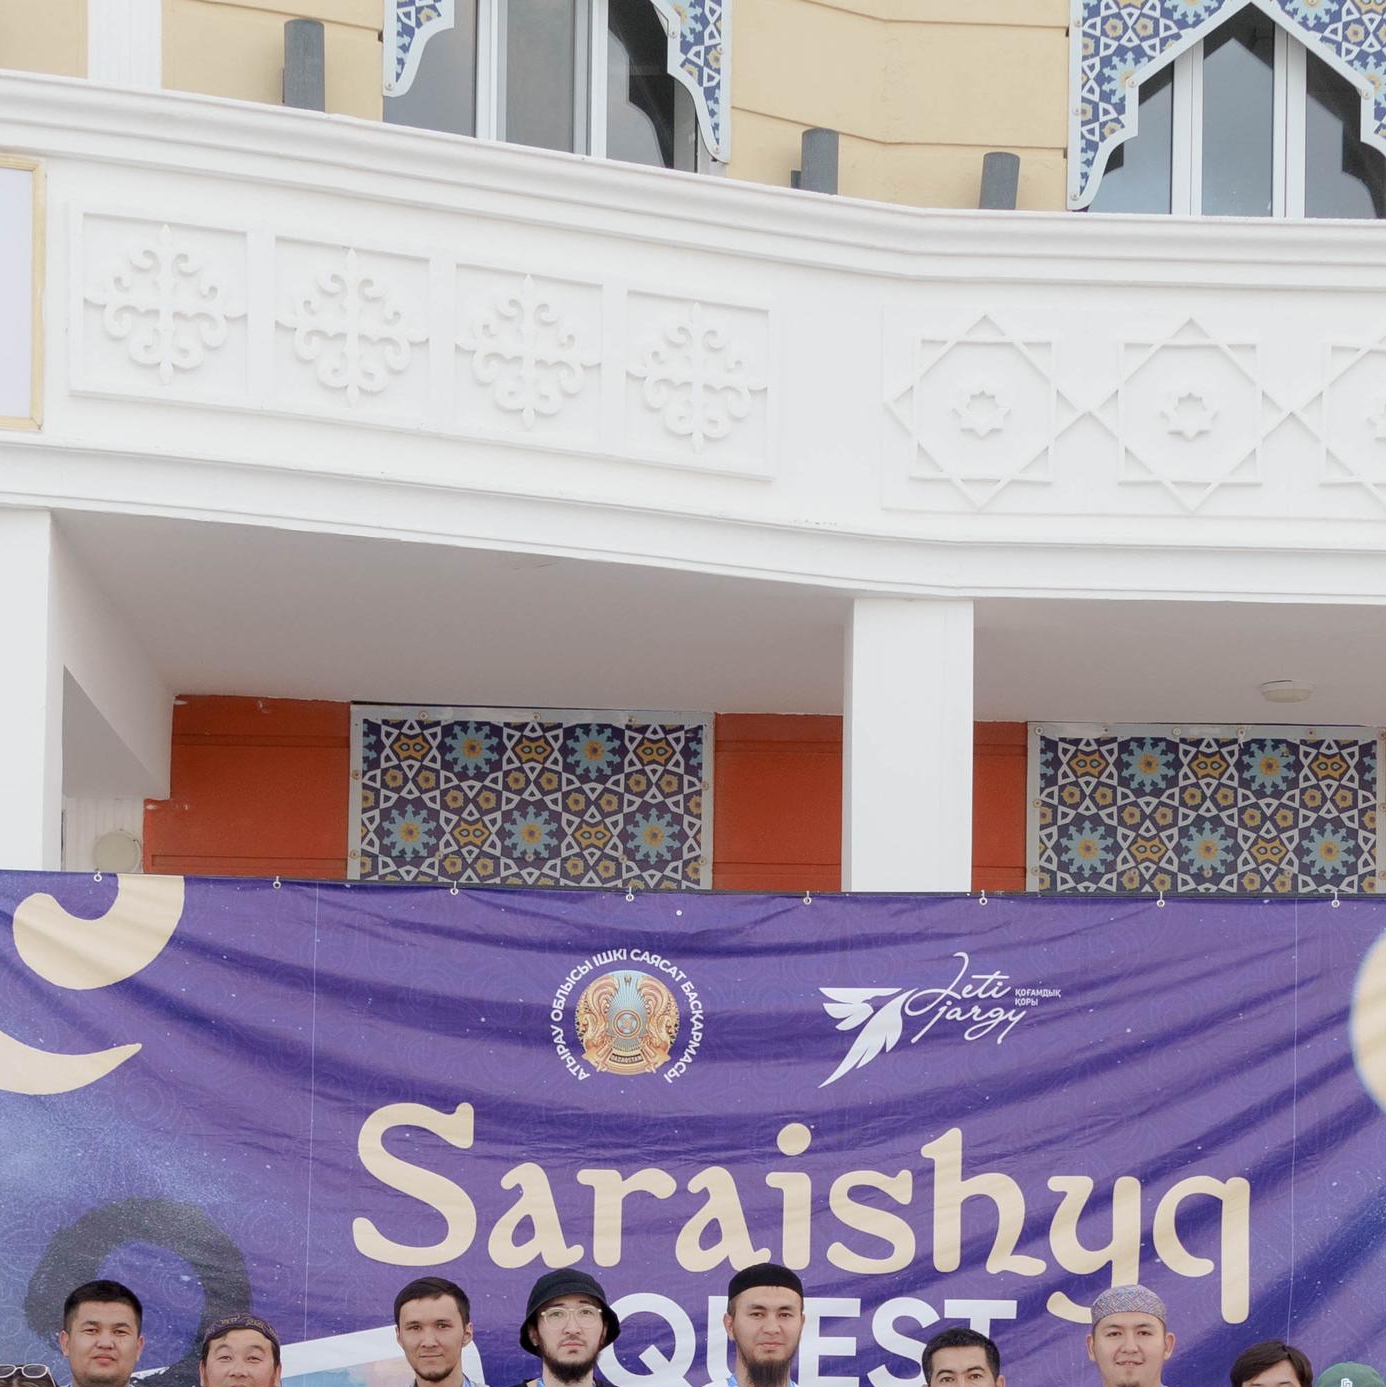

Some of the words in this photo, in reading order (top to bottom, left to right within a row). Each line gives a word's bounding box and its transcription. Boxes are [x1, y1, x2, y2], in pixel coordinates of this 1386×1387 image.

[593, 948, 627, 967] ІШКІ
[630, 949, 687, 982] САЯСАТ
[550, 960, 594, 1022] ОБЛЫСЫ
[1014, 998, 1039, 1007] ҚОРЫ
[551, 1024, 591, 1081] АТЫРАУ
[352, 1101, 1250, 1324] Saraishyq
